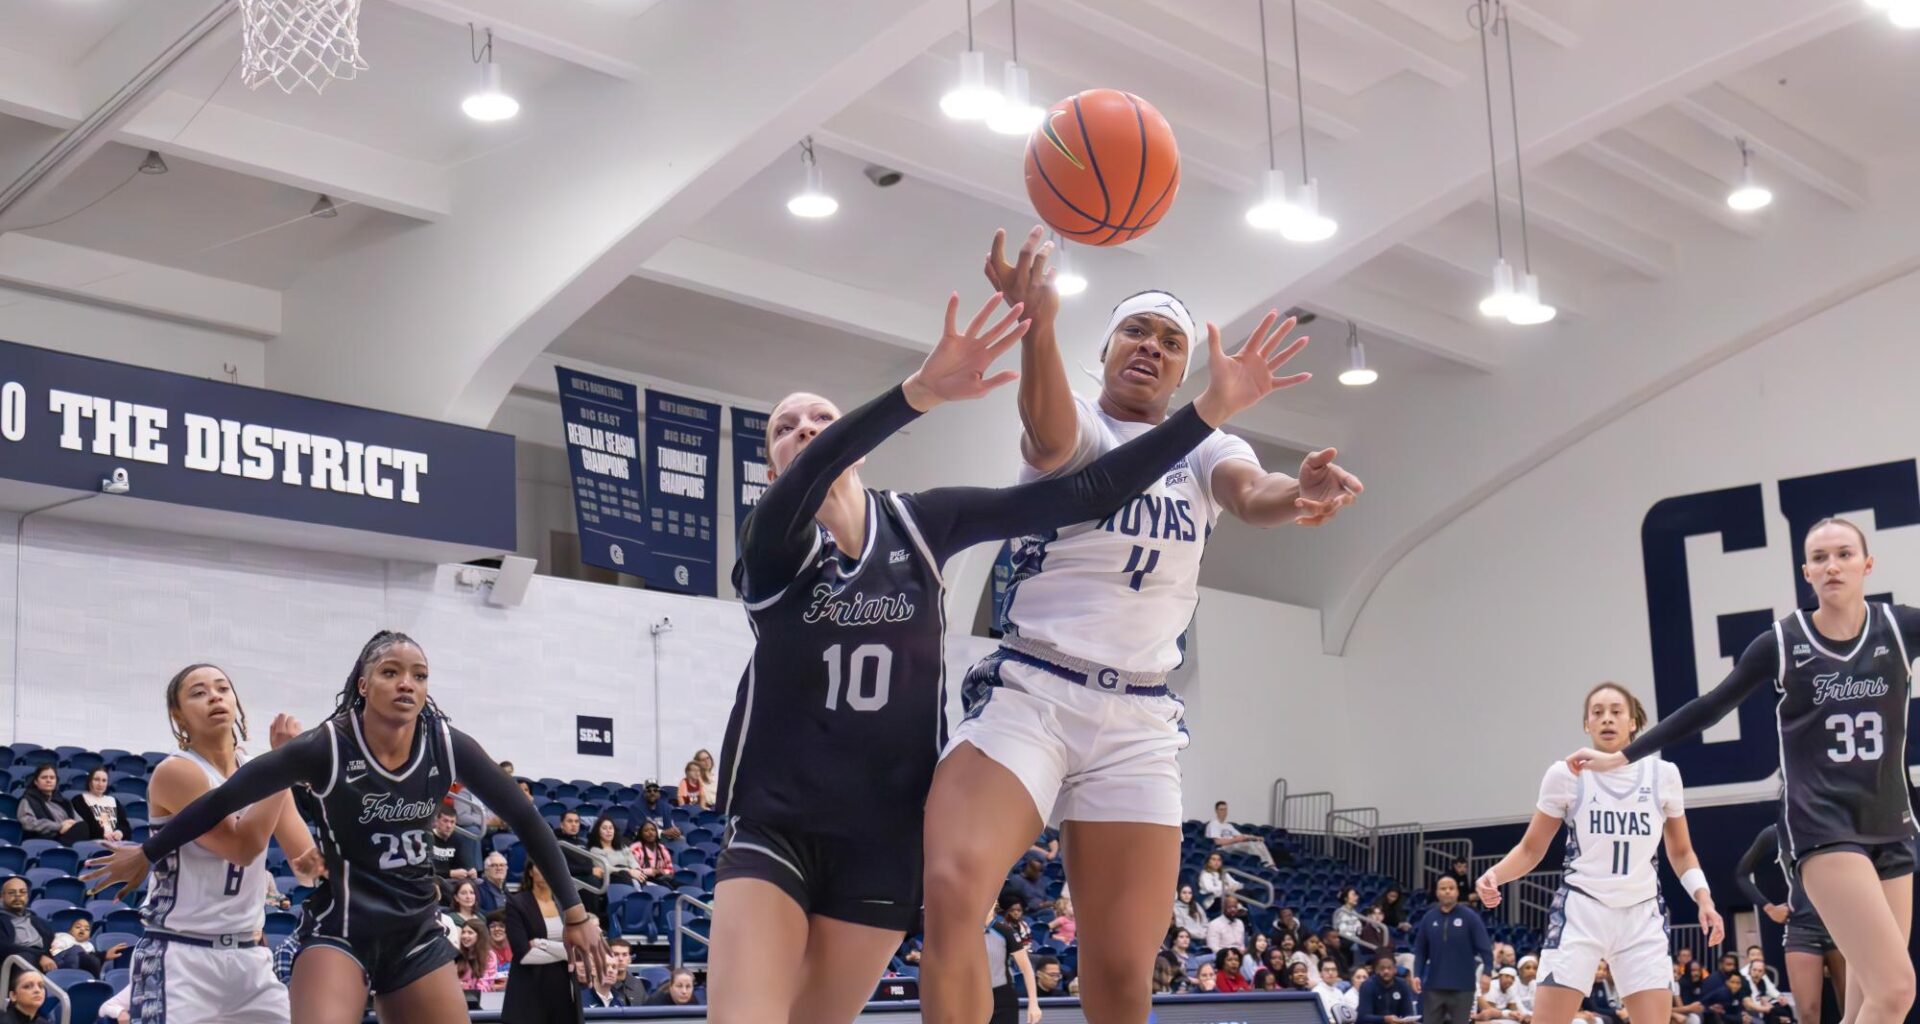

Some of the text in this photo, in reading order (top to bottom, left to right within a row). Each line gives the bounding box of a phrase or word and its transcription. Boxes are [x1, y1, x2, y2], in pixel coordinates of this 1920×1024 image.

[580, 407, 621, 427] BIG EAST
[50, 389, 168, 464] THE
[184, 412, 428, 503] DISTRICT
[567, 422, 637, 459] REGULAR SEASON
[664, 429, 702, 447] BIG EAST
[581, 447, 629, 480] CHAMPIONS
[657, 446, 707, 477] TOURNAMENT
[660, 470, 704, 499] CHAMPIONS
[1122, 545, 1160, 592] 4
[803, 583, 914, 626] Friars
[822, 643, 893, 712] 10
[1097, 667, 1120, 689] G
[1812, 671, 1889, 705] Friars
[579, 728, 602, 743] SEC.
[1825, 711, 1884, 763] 33
[359, 791, 436, 824] Friars
[1589, 810, 1651, 836] HOYAS
[371, 829, 428, 870] 20
[1612, 841, 1630, 875] 11
[220, 934, 233, 947] G
